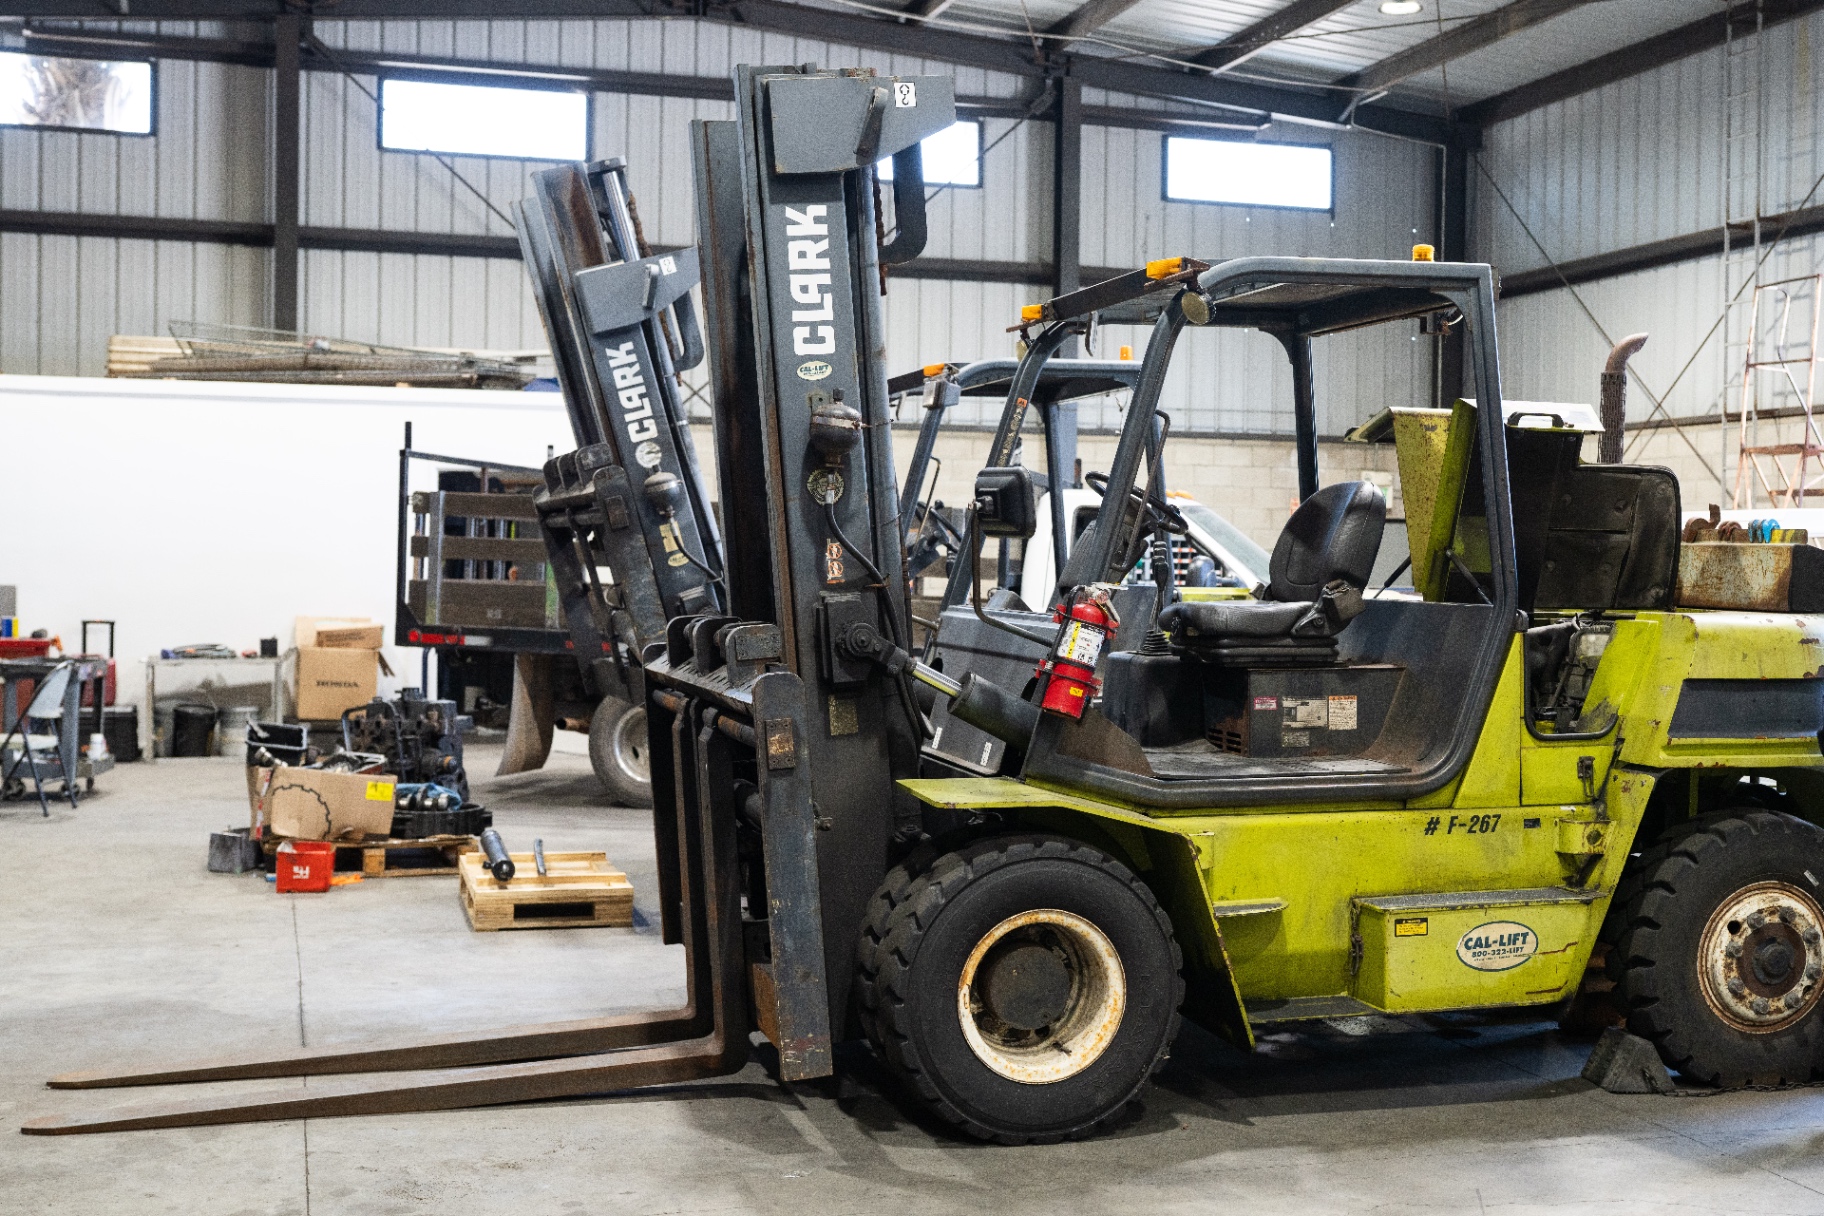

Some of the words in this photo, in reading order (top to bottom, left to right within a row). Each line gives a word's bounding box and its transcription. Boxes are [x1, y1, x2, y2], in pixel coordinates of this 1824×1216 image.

[785, 204, 836, 356] CLARK
[604, 341, 659, 444] CLARK
[1423, 816, 1441, 836] #
[1446, 813, 1502, 835] F-267
[1463, 931, 1530, 951] CAL-LIFT
[1471, 946, 1525, 958] 800-322-LIFT
